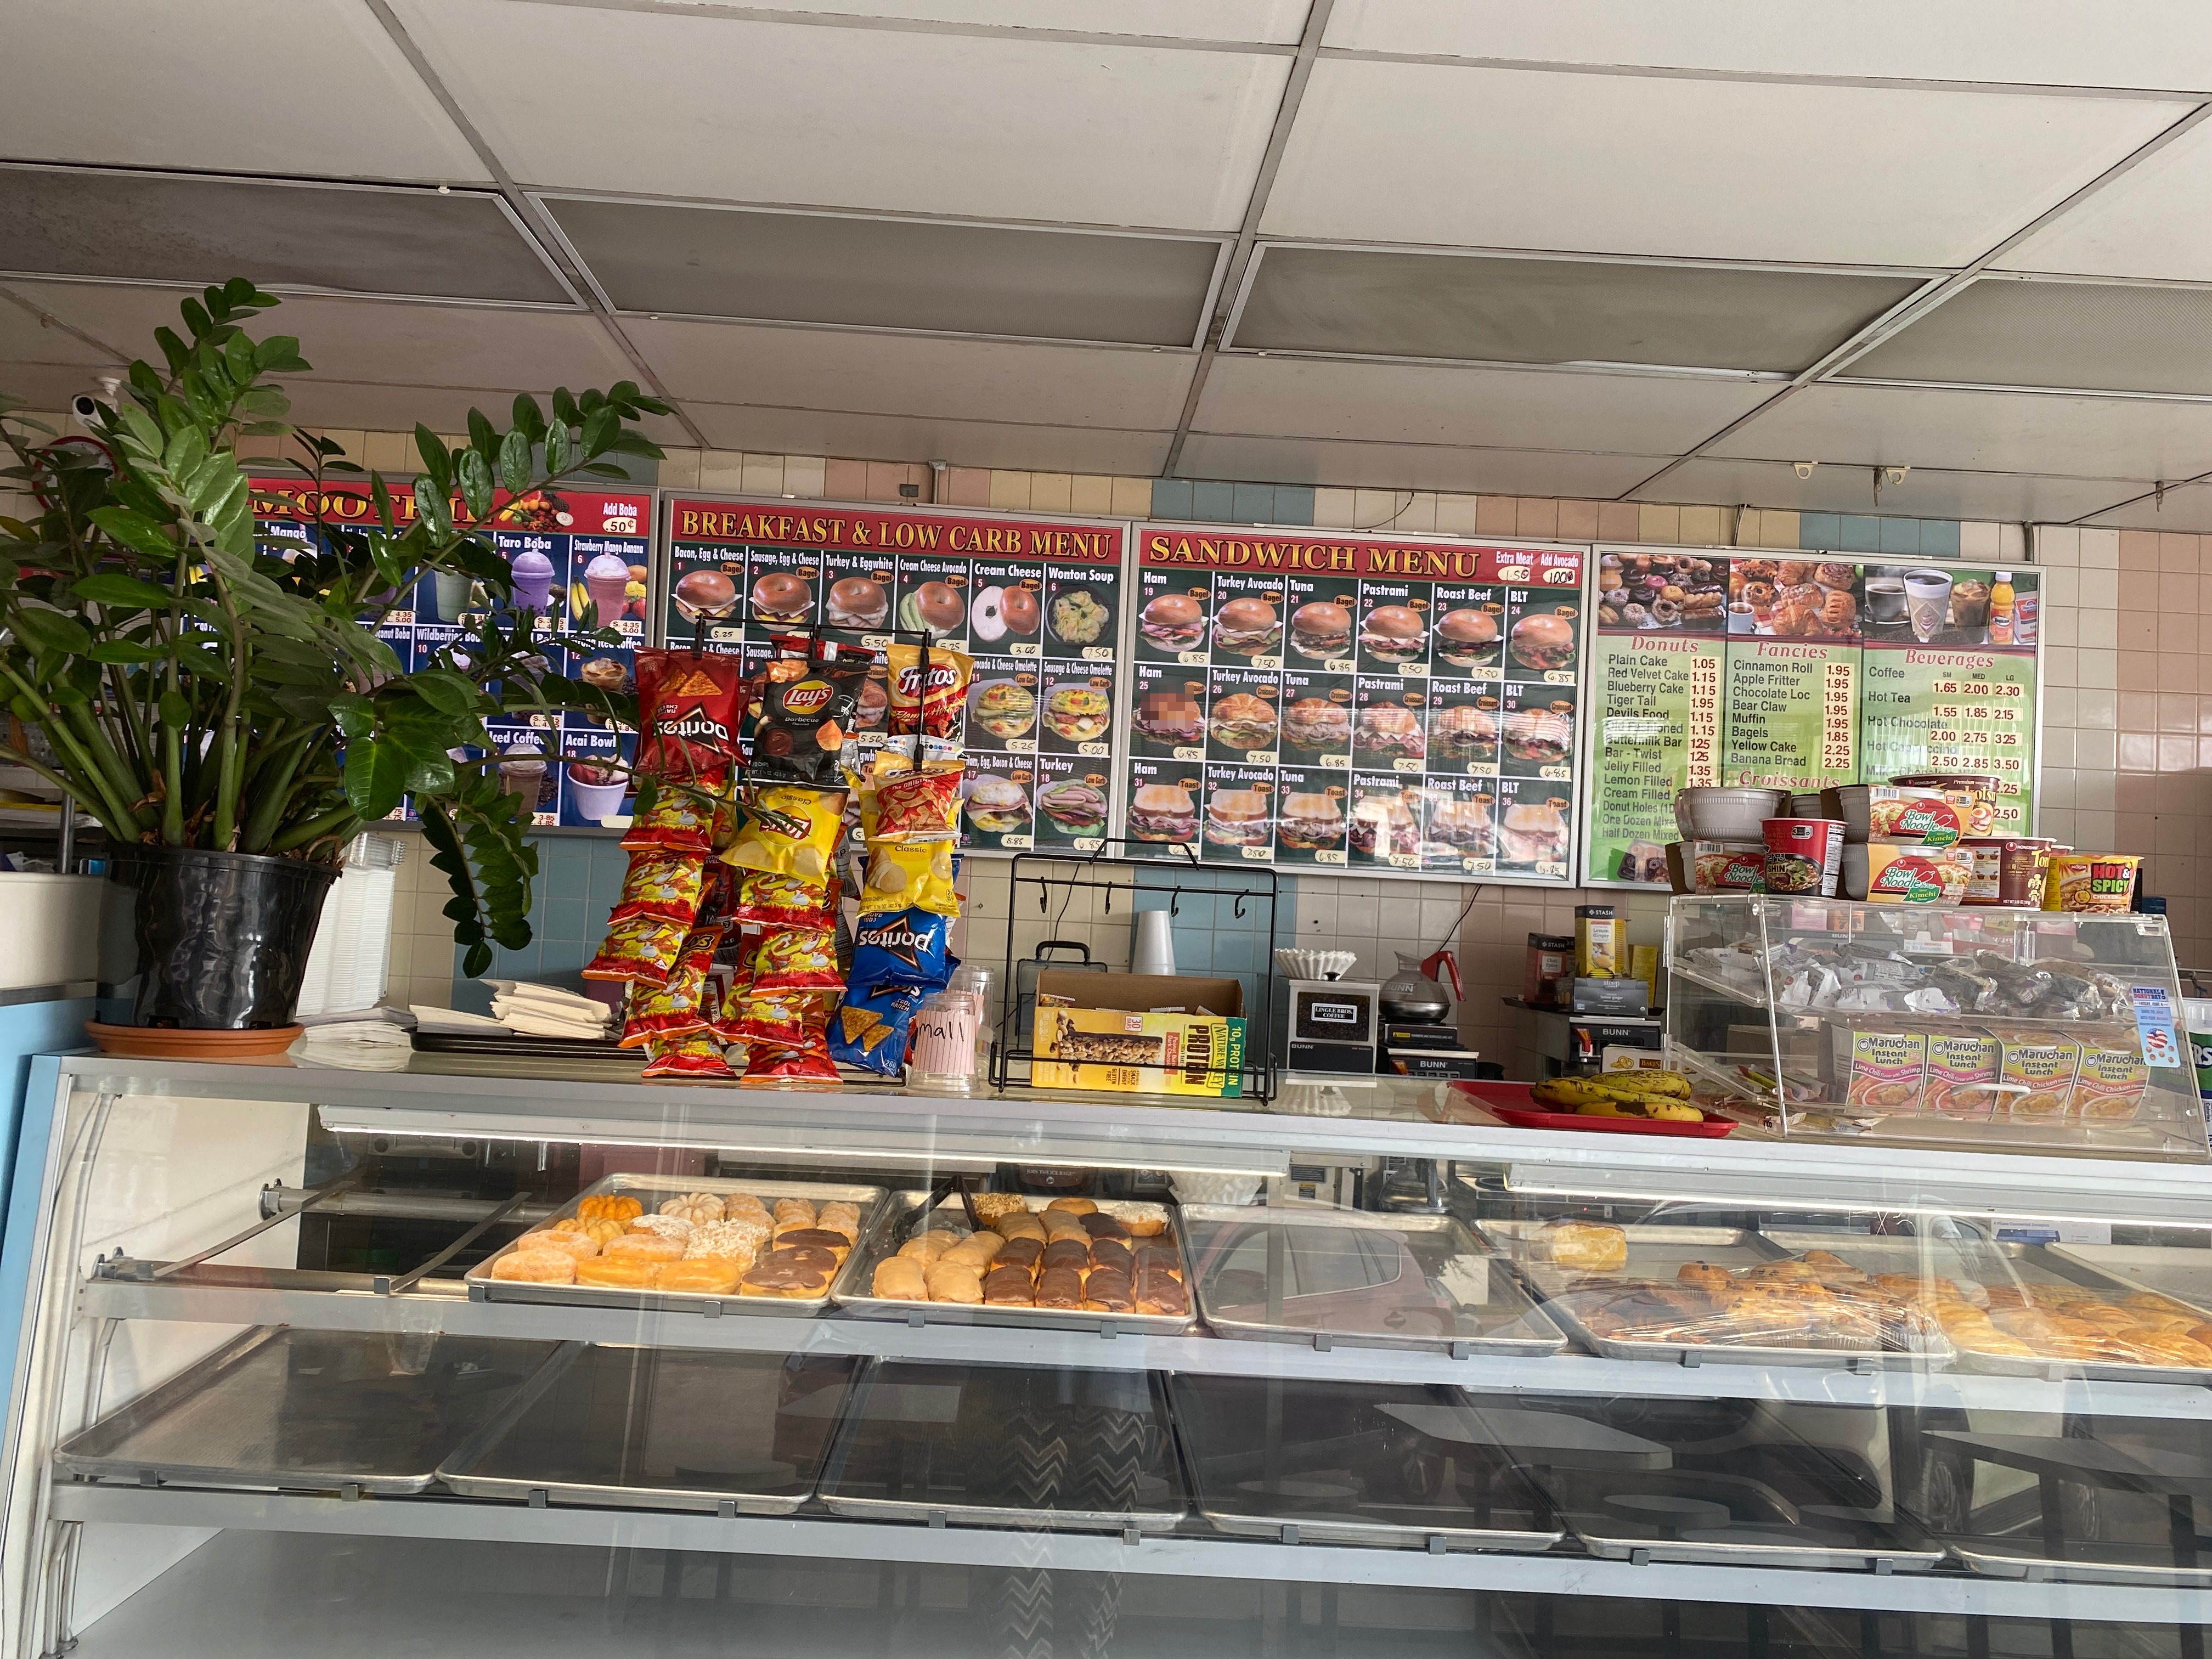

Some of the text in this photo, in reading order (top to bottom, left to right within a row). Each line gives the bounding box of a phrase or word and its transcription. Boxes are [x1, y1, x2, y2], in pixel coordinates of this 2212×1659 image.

[603, 502, 637, 516] Add Boba
[270, 526, 306, 539] Mango
[681, 510, 1111, 558] BREAKFAST & LOW CARB MENU
[499, 536, 551, 549] Taro Boba
[574, 539, 644, 555] Strawberry Mango Banana
[675, 546, 743, 562] Bacon, Egg & Cheese
[751, 550, 819, 566] Sausage, Egg & Cheese
[1150, 536, 1481, 577] SANDWICH MENU
[1496, 551, 1533, 566] Extra Meat
[1541, 553, 1579, 567] Add Avocado
[826, 554, 893, 572] Turkey & Eggwhite
[900, 558, 967, 574] Cream Cheese Avocado
[974, 563, 1041, 578] Cream Cheese
[1048, 567, 1114, 584] Wonton Soup
[1144, 572, 1167, 584] Ham
[1217, 575, 1283, 591] Turkey Avocado
[1290, 579, 1313, 592] Tuna
[1363, 583, 1408, 597] Pastrami
[1218, 591, 1227, 600] 20
[1437, 588, 1492, 601] Roast Beef
[1511, 591, 1528, 603] BLT
[864, 638, 888, 648] 5.50
[1630, 636, 1699, 653] Donuts
[1757, 642, 1827, 659] Fancies
[1609, 654, 1715, 669] Plain Cake 1.05
[1905, 648, 1994, 670] Beverages
[1044, 662, 1112, 676] Sausage & Cheese Omelette
[1139, 666, 1162, 678] Ham
[1734, 659, 1813, 673] Cinnamon Roll
[1869, 667, 1905, 678] Coffee
[1212, 669, 1278, 685] Turkey Avocado
[1285, 674, 1309, 686] Tuna
[1608, 668, 1689, 681] Red Velvet Cake
[1733, 673, 1848, 689] Apple Fritter 1.95
[1358, 678, 1403, 691] Pastrami
[1432, 681, 1487, 695] Roast Beef
[1506, 685, 1523, 697] BLT
[1607, 681, 1684, 695] Blueberry Cake
[1964, 684, 1989, 695] 2.00
[786, 687, 830, 707] Lay's
[1733, 686, 1810, 699] Chocolate Loc
[1868, 691, 1910, 703] Hot Tea
[1607, 694, 1656, 707] Tiger Tail
[1733, 700, 1787, 712] Bear Claw
[1607, 707, 1639, 718] Devils
[1732, 713, 1765, 724] Muffin
[1867, 716, 1948, 730] Hot Chocolate
[1732, 726, 1768, 739] Bagels
[1931, 731, 1956, 741] 2.00
[565, 734, 616, 748] Acai Bowl
[1731, 740, 1849, 755] Yellow Cake 2.25
[1634, 748, 1662, 759] Twist
[1731, 753, 1806, 766] Banana Bread
[1040, 758, 1074, 773] Turkey
[1605, 761, 1661, 774] Jelly Filled
[1932, 756, 1957, 766] 2.50
[1604, 774, 1672, 787] Lemon Filled
[1740, 771, 1839, 788] Croissants
[1604, 787, 1670, 800] Cream Filled
[1603, 801, 1661, 812] Donut Holes
[1906, 809, 1936, 822] Bowl
[1901, 820, 1938, 832] Noodle
[1602, 827, 1679, 840] Half Dozen Mixed
[1886, 868, 1916, 879] Bowl
[2094, 865, 2123, 879] HOT
[1881, 877, 1921, 889] Noodle
[2092, 879, 2129, 893] SPICY
[1909, 891, 1936, 899] Kimchi
[1385, 984, 1414, 992] BUNN
[891, 1002, 910, 1012] RANCH
[1214, 1027, 1227, 1057] NATURE
[1869, 1037, 1920, 1049] Maruchan
[1943, 1041, 1994, 1053] Maruchan
[1872, 1049, 1907, 1058] Instant
[1946, 1052, 1981, 1061] Instant
[2018, 1049, 2073, 1060] Maruchan
[1420, 1060, 1446, 1069] BUNN
[1875, 1057, 1903, 1065] Lunch
[1949, 1060, 1977, 1068] Lunch
[2022, 1060, 2058, 1069] Instant
[1855, 1063, 1921, 1076] Lime Chili Shrimp
[2098, 1065, 2133, 1074] Instant
[2100, 1072, 2128, 1080] Lunch
[2078, 1078, 2131, 1092] Lime Chili Chicken
